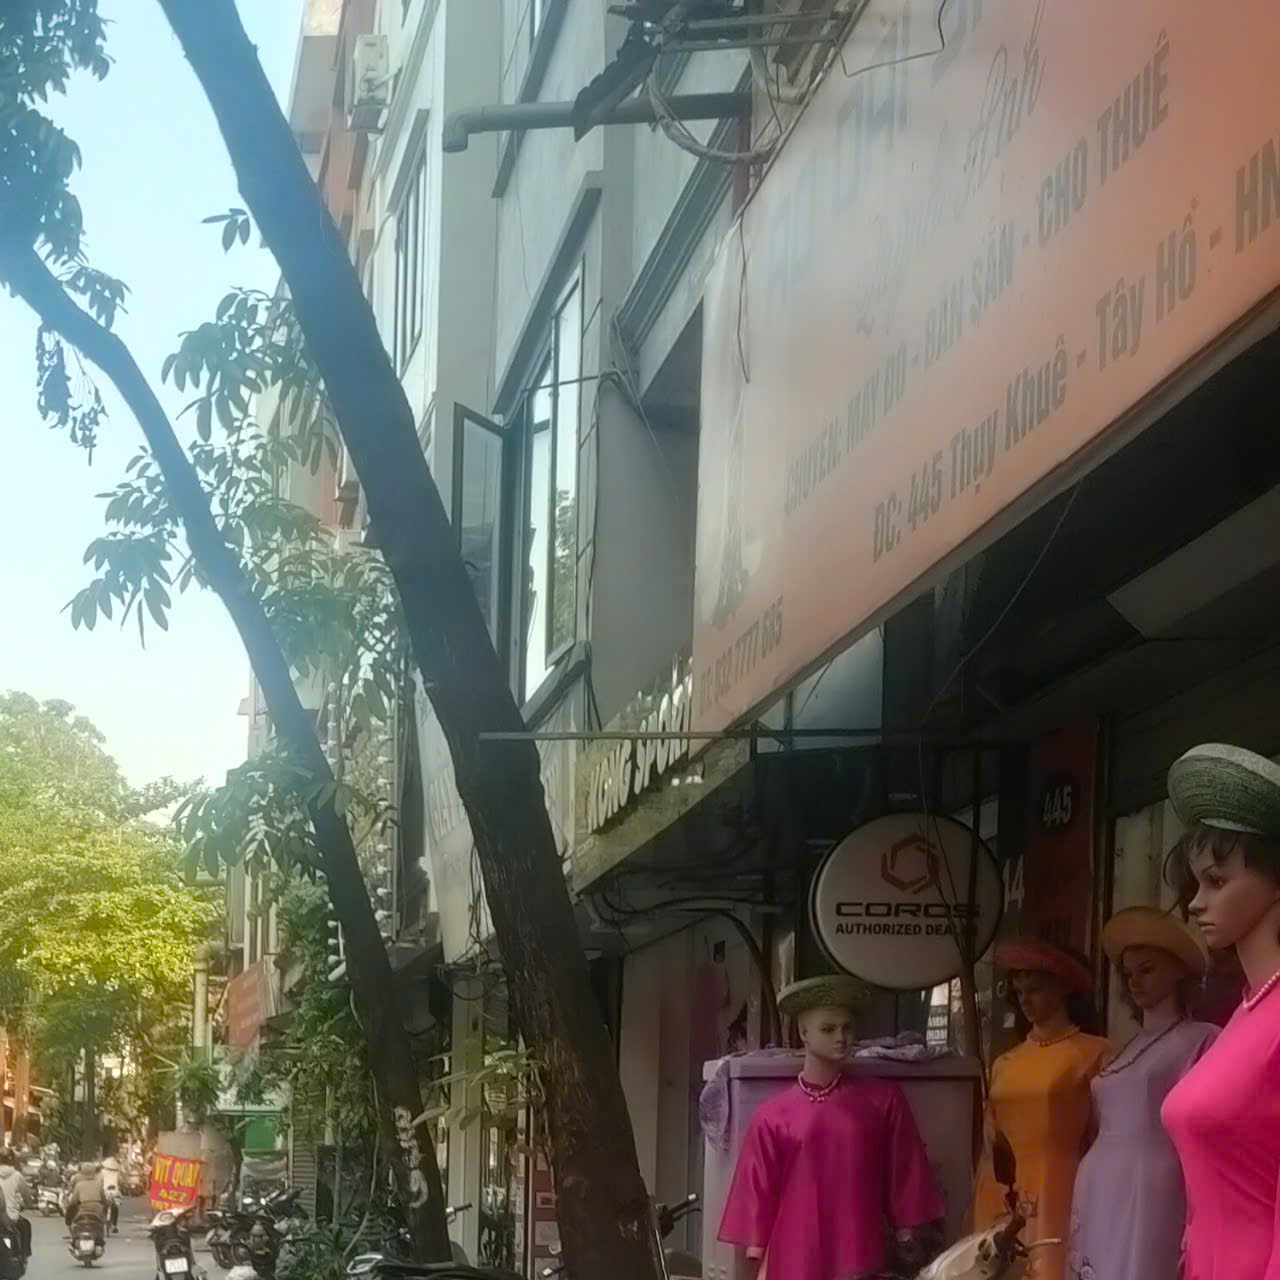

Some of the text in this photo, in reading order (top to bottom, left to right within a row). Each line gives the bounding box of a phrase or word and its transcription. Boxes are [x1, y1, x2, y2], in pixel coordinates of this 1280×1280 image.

[1037, 136, 1088, 248] CHO
[1096, 27, 1170, 186] THUÊ
[907, 449, 943, 533] 445
[950, 408, 999, 499] Thụy
[1006, 333, 1068, 452] Khuê
[1096, 274, 1146, 373] Tây
[1155, 193, 1199, 324] Hồ
[1042, 785, 1073, 829] 445
[835, 923, 920, 936] AUTHORIZED
[173, 1160, 201, 1187] QUAY
